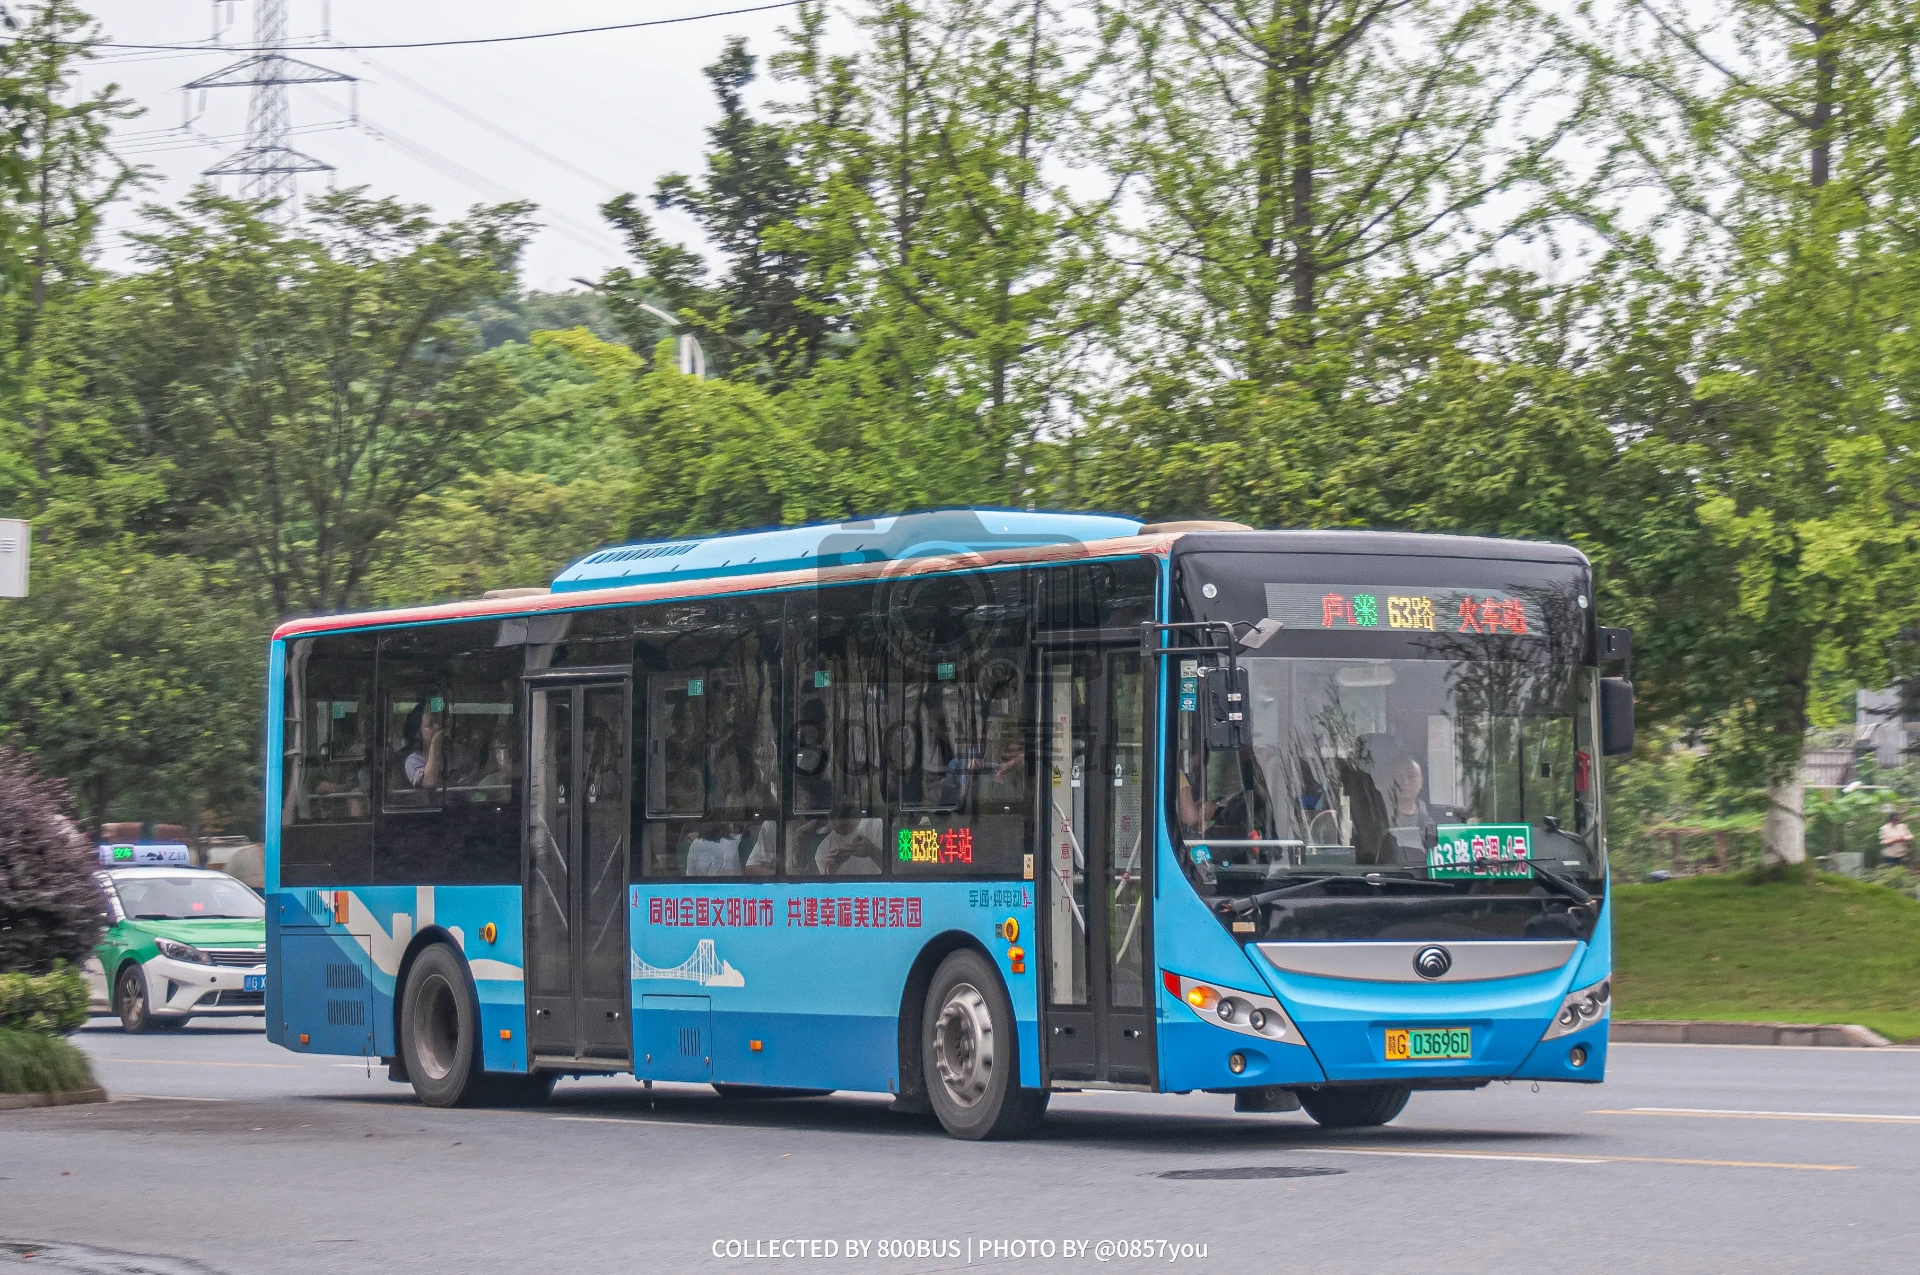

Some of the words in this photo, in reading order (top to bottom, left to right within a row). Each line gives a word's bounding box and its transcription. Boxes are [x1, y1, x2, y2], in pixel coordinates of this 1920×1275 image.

[1386, 595, 1435, 631] 63路
[1457, 595, 1527, 634] 火车站
[912, 828, 940, 863] 63路
[648, 896, 774, 928] 同创全国文明城市
[787, 896, 923, 928] 共建幸福美好家园
